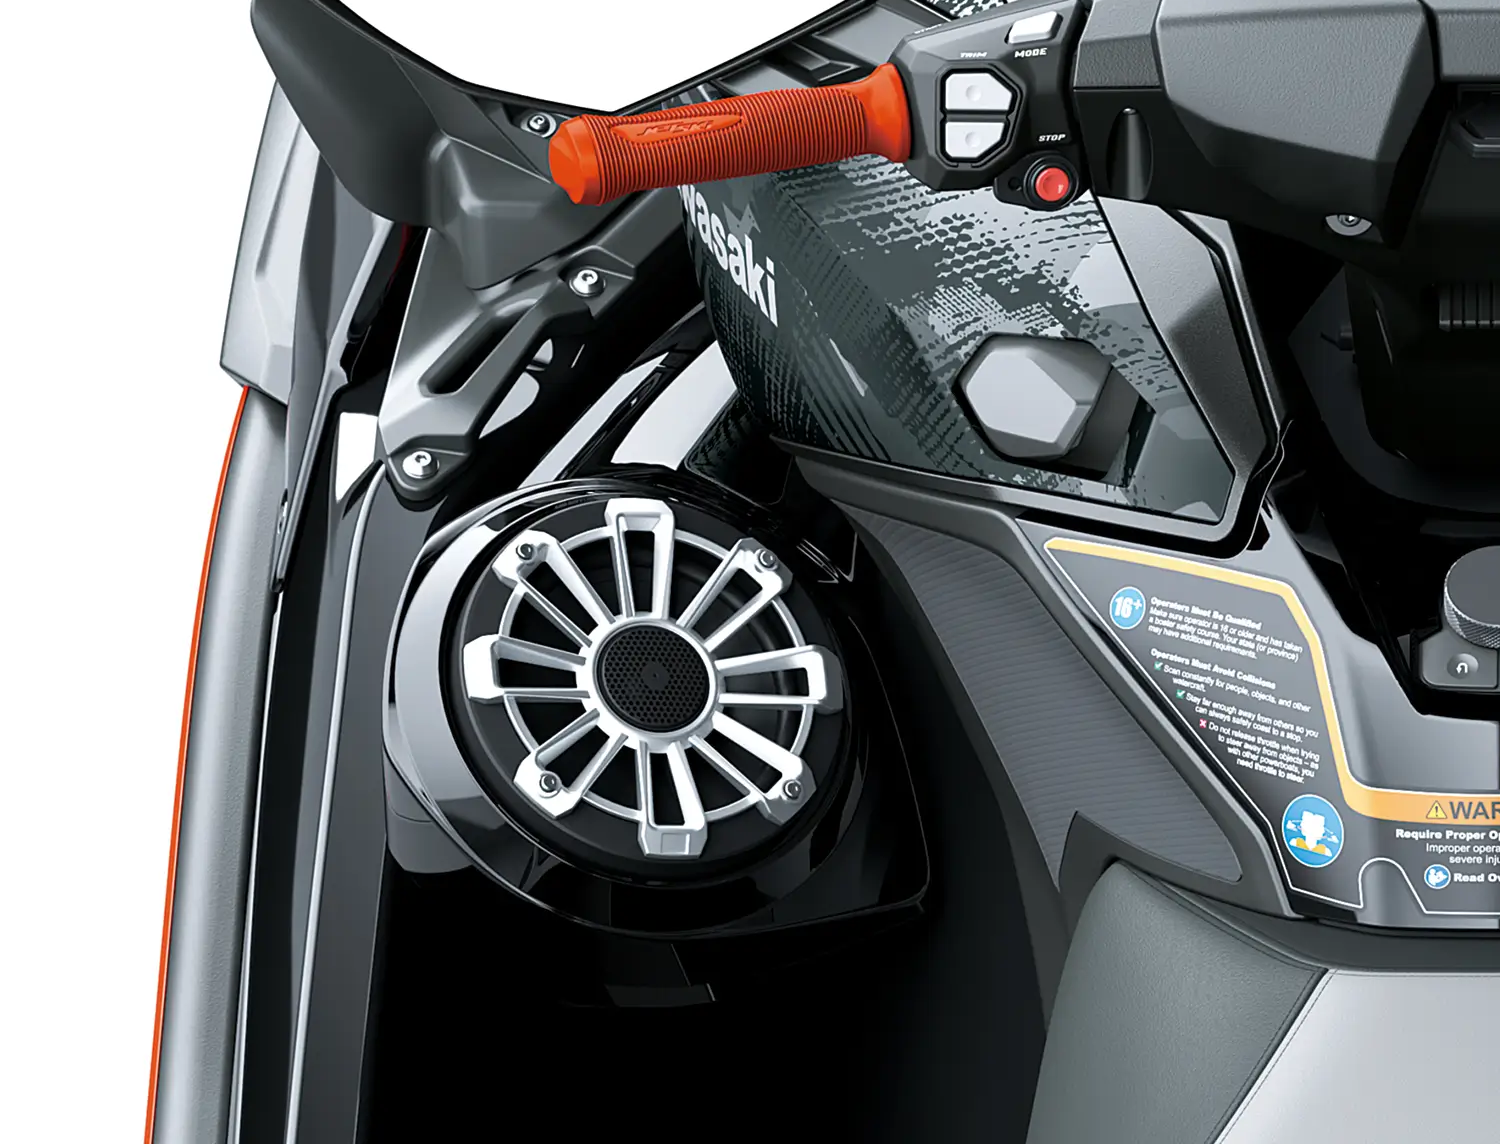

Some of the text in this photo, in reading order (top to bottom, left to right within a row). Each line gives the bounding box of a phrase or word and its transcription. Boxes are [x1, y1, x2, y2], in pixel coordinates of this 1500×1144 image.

[1014, 47, 1048, 58] MODE
[1038, 134, 1066, 142] STOP
[677, 184, 778, 327] wasaki
[1396, 828, 1442, 840] Require
[1446, 830, 1486, 841] Proper
[1426, 843, 1470, 854] Improper
[1449, 856, 1482, 864] severe
[1454, 873, 1484, 882] Read
